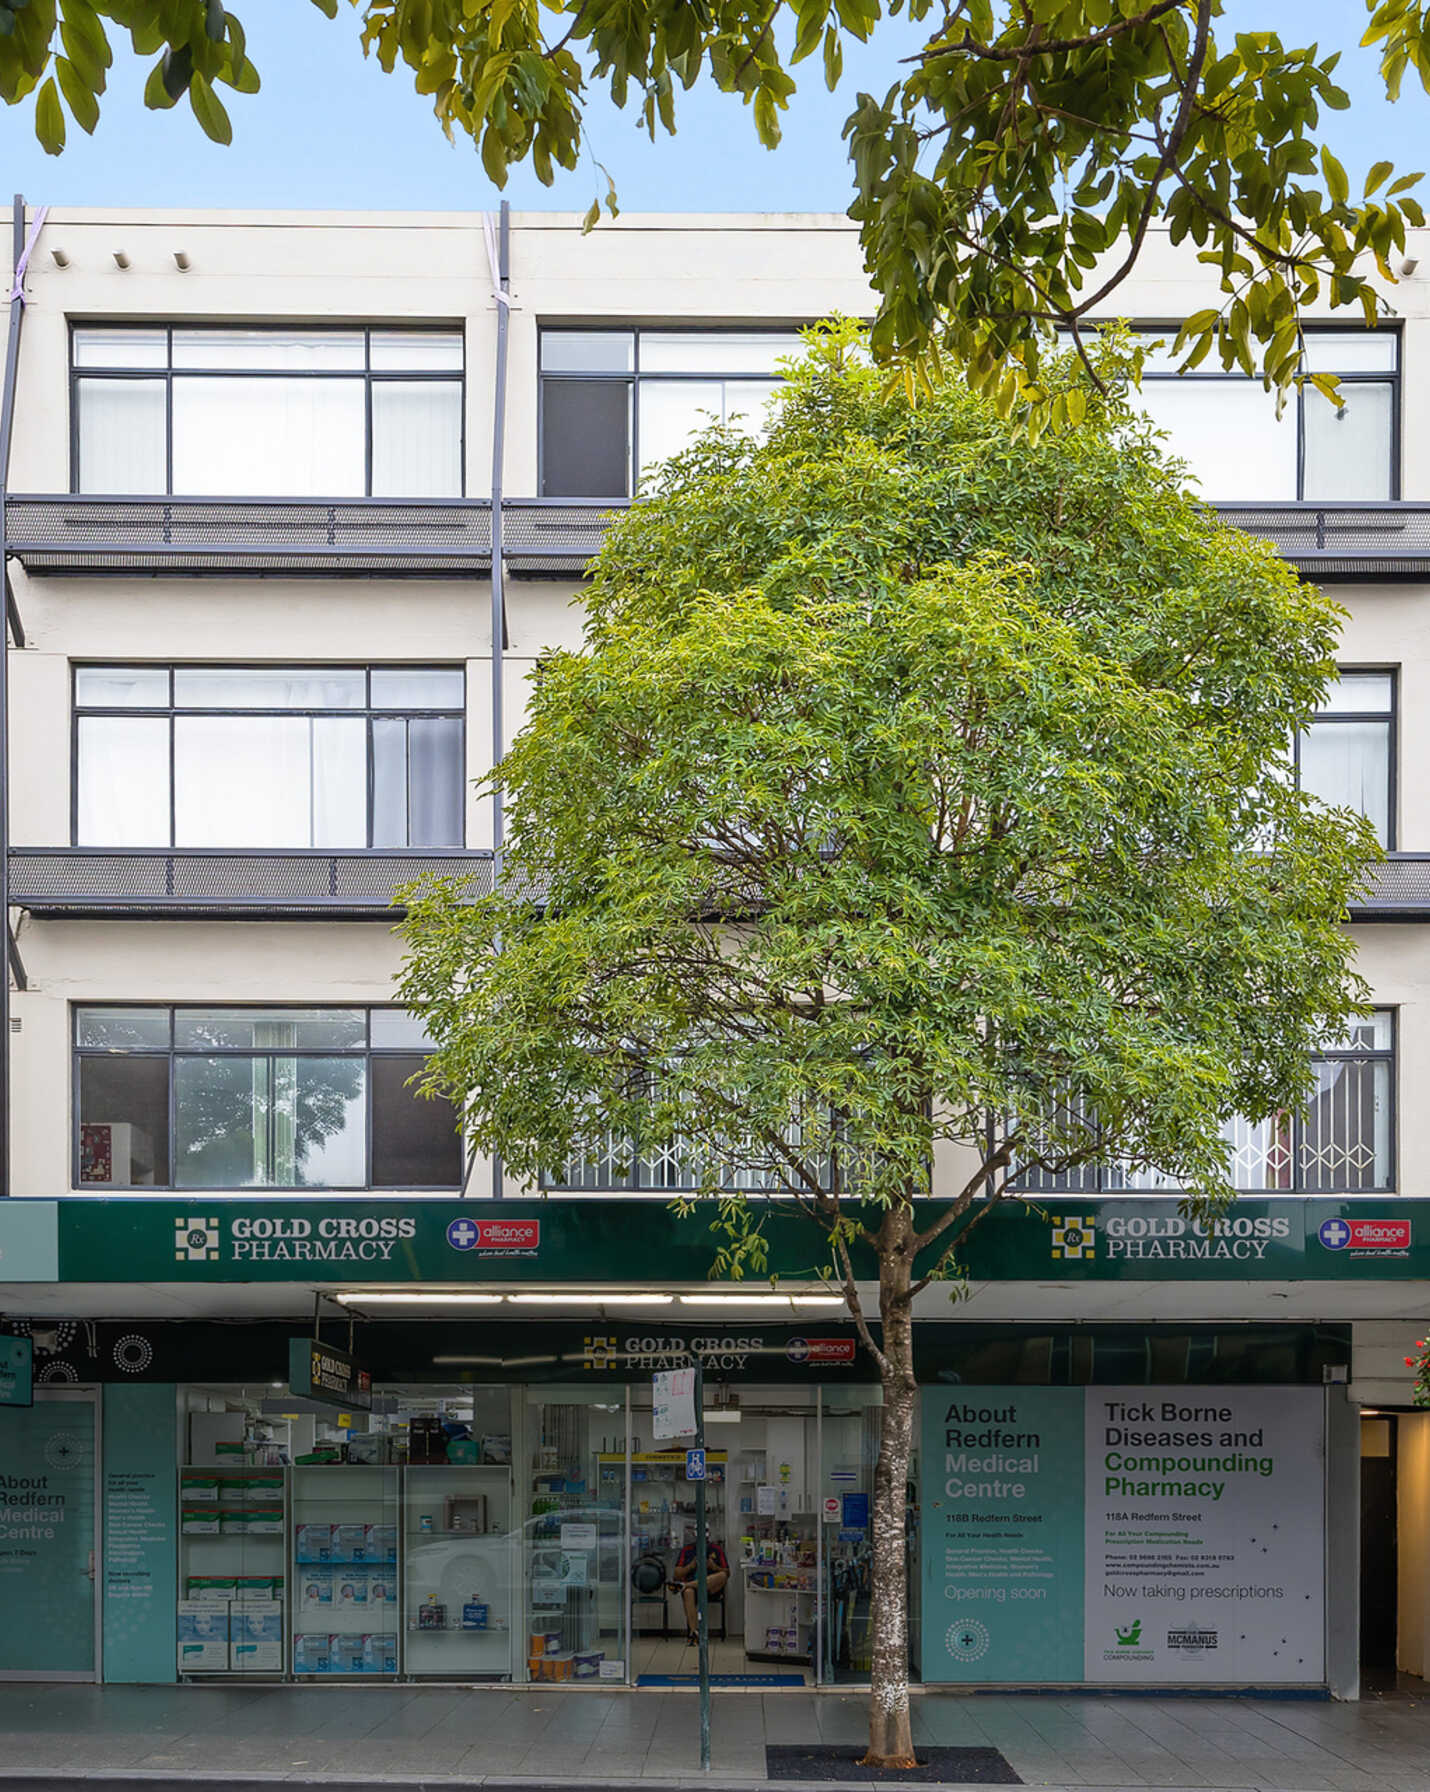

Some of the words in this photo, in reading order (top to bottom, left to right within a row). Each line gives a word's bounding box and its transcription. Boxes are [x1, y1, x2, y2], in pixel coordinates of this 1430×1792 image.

[231, 1217, 311, 1238] GOLD
[318, 1217, 416, 1238] CROSS
[483, 1224, 533, 1238] alliance
[1106, 1217, 1186, 1238] GOLD
[1192, 1217, 1290, 1239] CROSS
[1354, 1224, 1405, 1238] alliance
[231, 1241, 395, 1261] PHARMACY
[1106, 1240, 1270, 1260] PHARMACY
[624, 1337, 686, 1353] GOLD
[690, 1337, 764, 1353] CROSS
[810, 1344, 850, 1353] alliance
[945, 1404, 1018, 1424] About
[1104, 1403, 1155, 1423] Tick
[1160, 1403, 1232, 1423] Borne
[945, 1429, 1041, 1449] Redfern
[1104, 1428, 1213, 1448] Diseases
[1219, 1428, 1264, 1448] and
[945, 1453, 1040, 1474] Medical
[1104, 1453, 1274, 1477] Compounding
[945, 1478, 1026, 1498] Centre
[1104, 1477, 1225, 1500] Pharmacy
[0, 1492, 65, 1506] Redfern
[971, 1514, 1010, 1523] Redfern
[1012, 1514, 1043, 1523] Street
[1105, 1512, 1129, 1521] 118A
[1130, 1512, 1170, 1521] Redfern
[1171, 1512, 1202, 1521] Street
[0, 1525, 55, 1540] Centre
[944, 1585, 1007, 1602] Opening
[1011, 1587, 1047, 1600] soon
[1104, 1584, 1138, 1598] Now
[1142, 1584, 1186, 1601] taking
[1190, 1584, 1284, 1601] prescriptions
[1167, 1635, 1218, 1645] MCMANUS
[1103, 1654, 1155, 1662] COMPOUNDING
